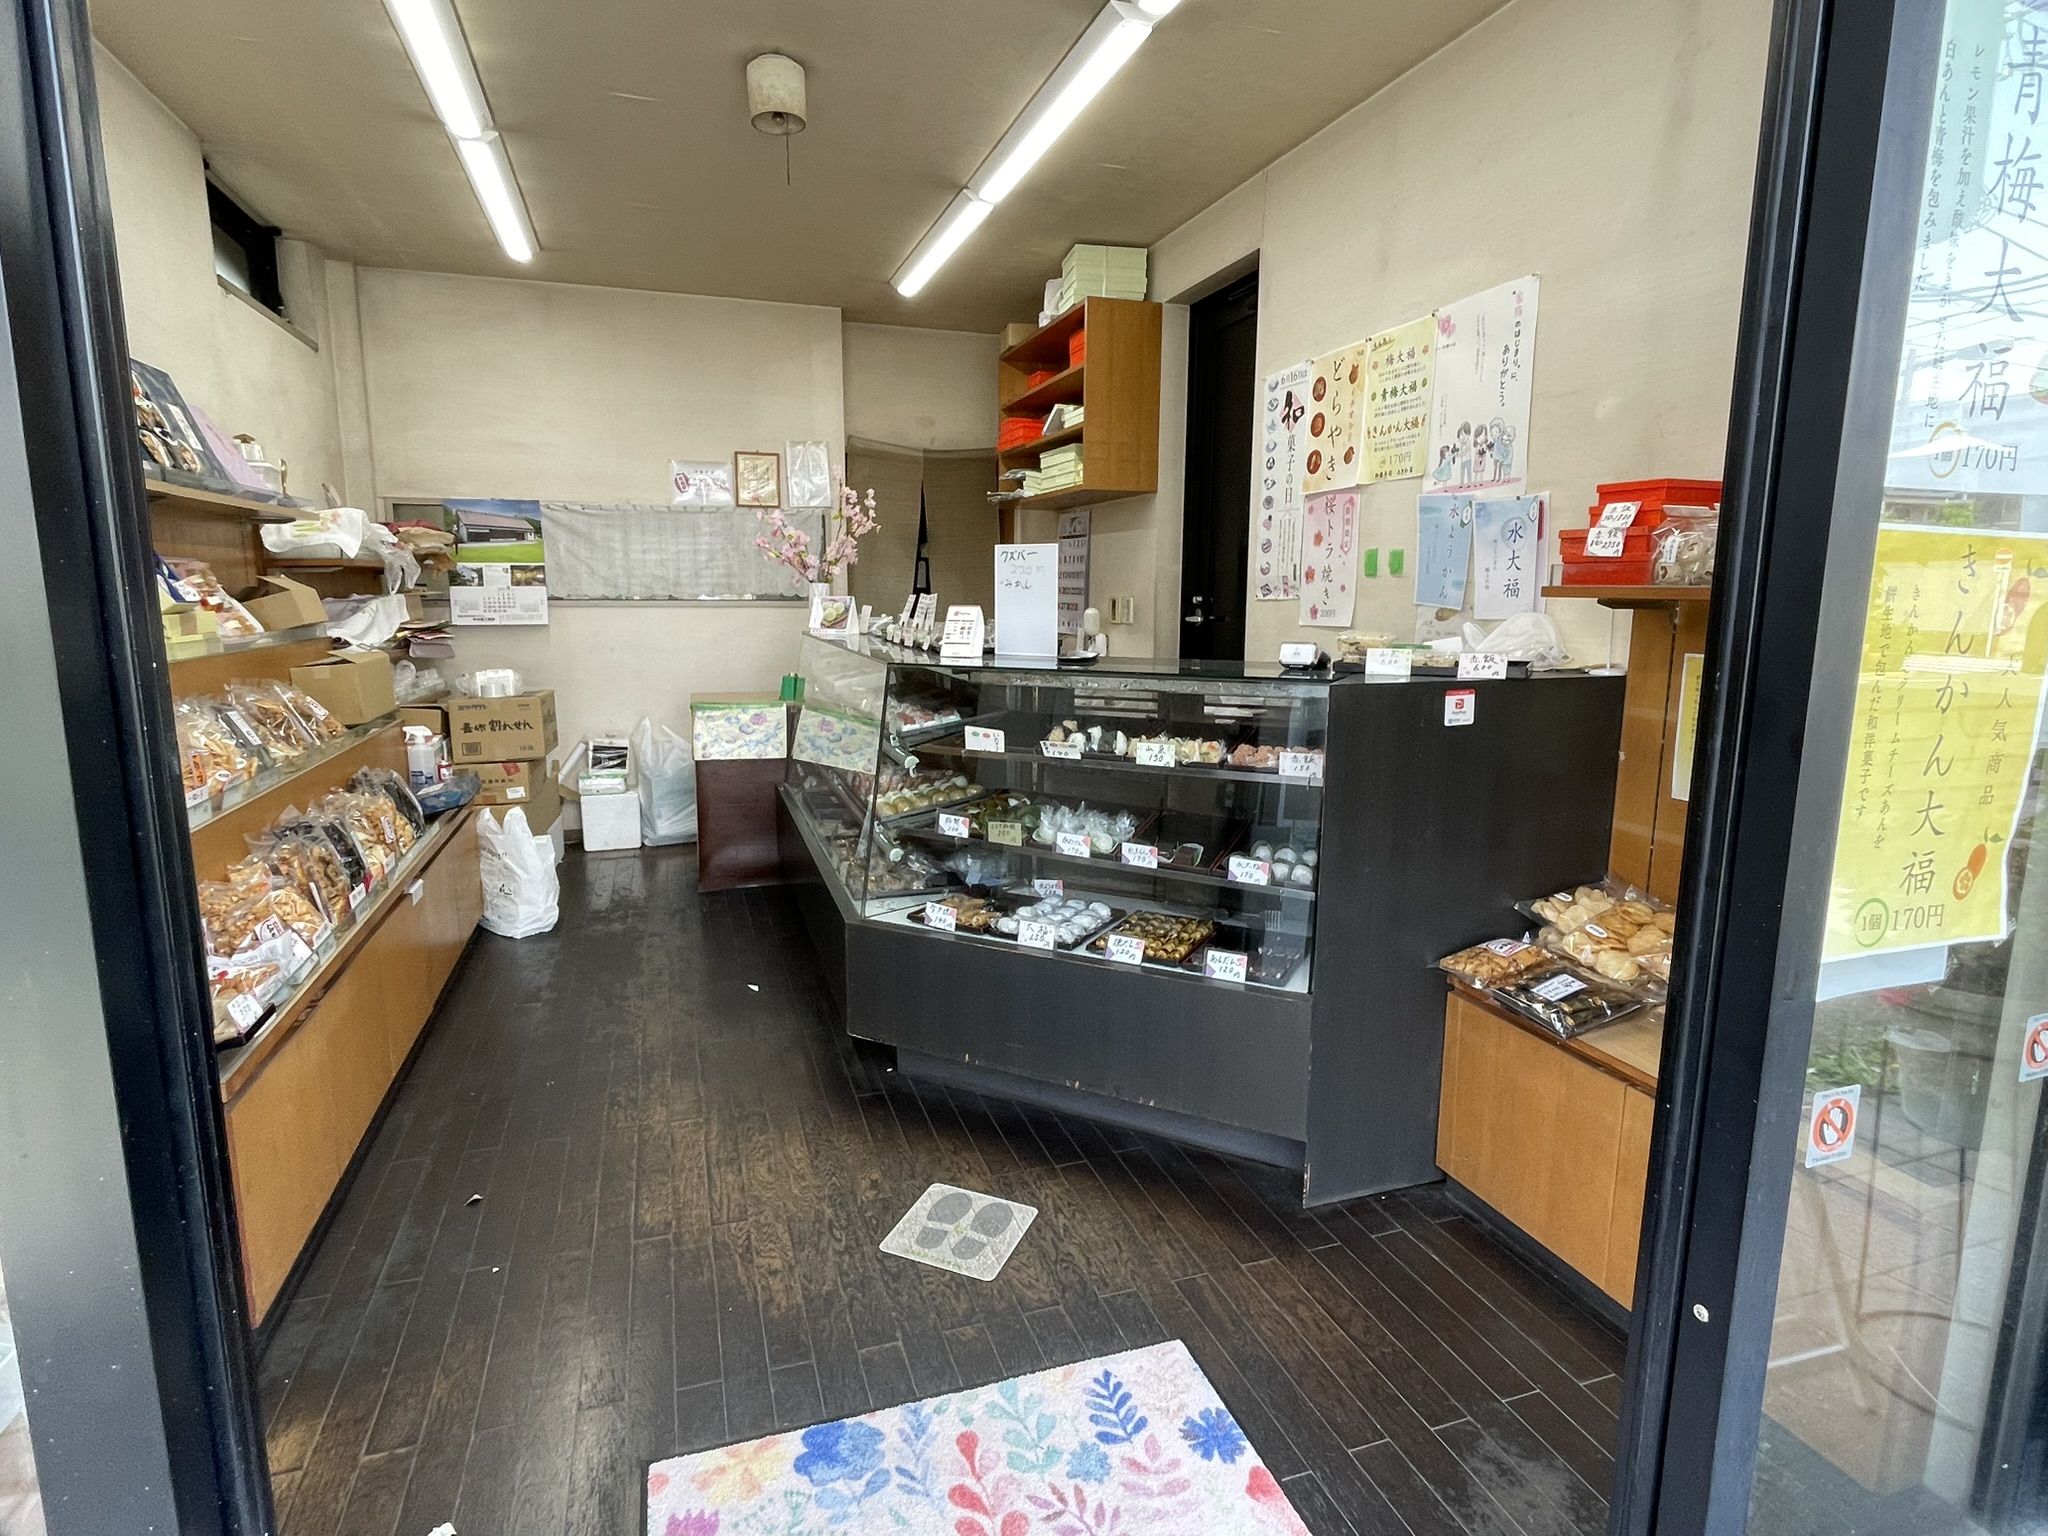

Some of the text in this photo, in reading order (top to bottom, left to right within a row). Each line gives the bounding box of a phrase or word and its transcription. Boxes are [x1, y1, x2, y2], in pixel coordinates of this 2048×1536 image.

[1958, 26, 2048, 422] 青梅大福
[1326, 357, 1346, 481] どらやき
[1372, 416, 1420, 439] きんかん大福
[1380, 380, 1418, 402] 青梅大福
[1000, 550, 1038, 564] クズバー
[1439, 503, 1460, 600] 水ようかん
[1503, 521, 1524, 599] 水大福
[1898, 543, 1978, 897] きんかん大福
[1861, 903, 1946, 932] 1個 170円
